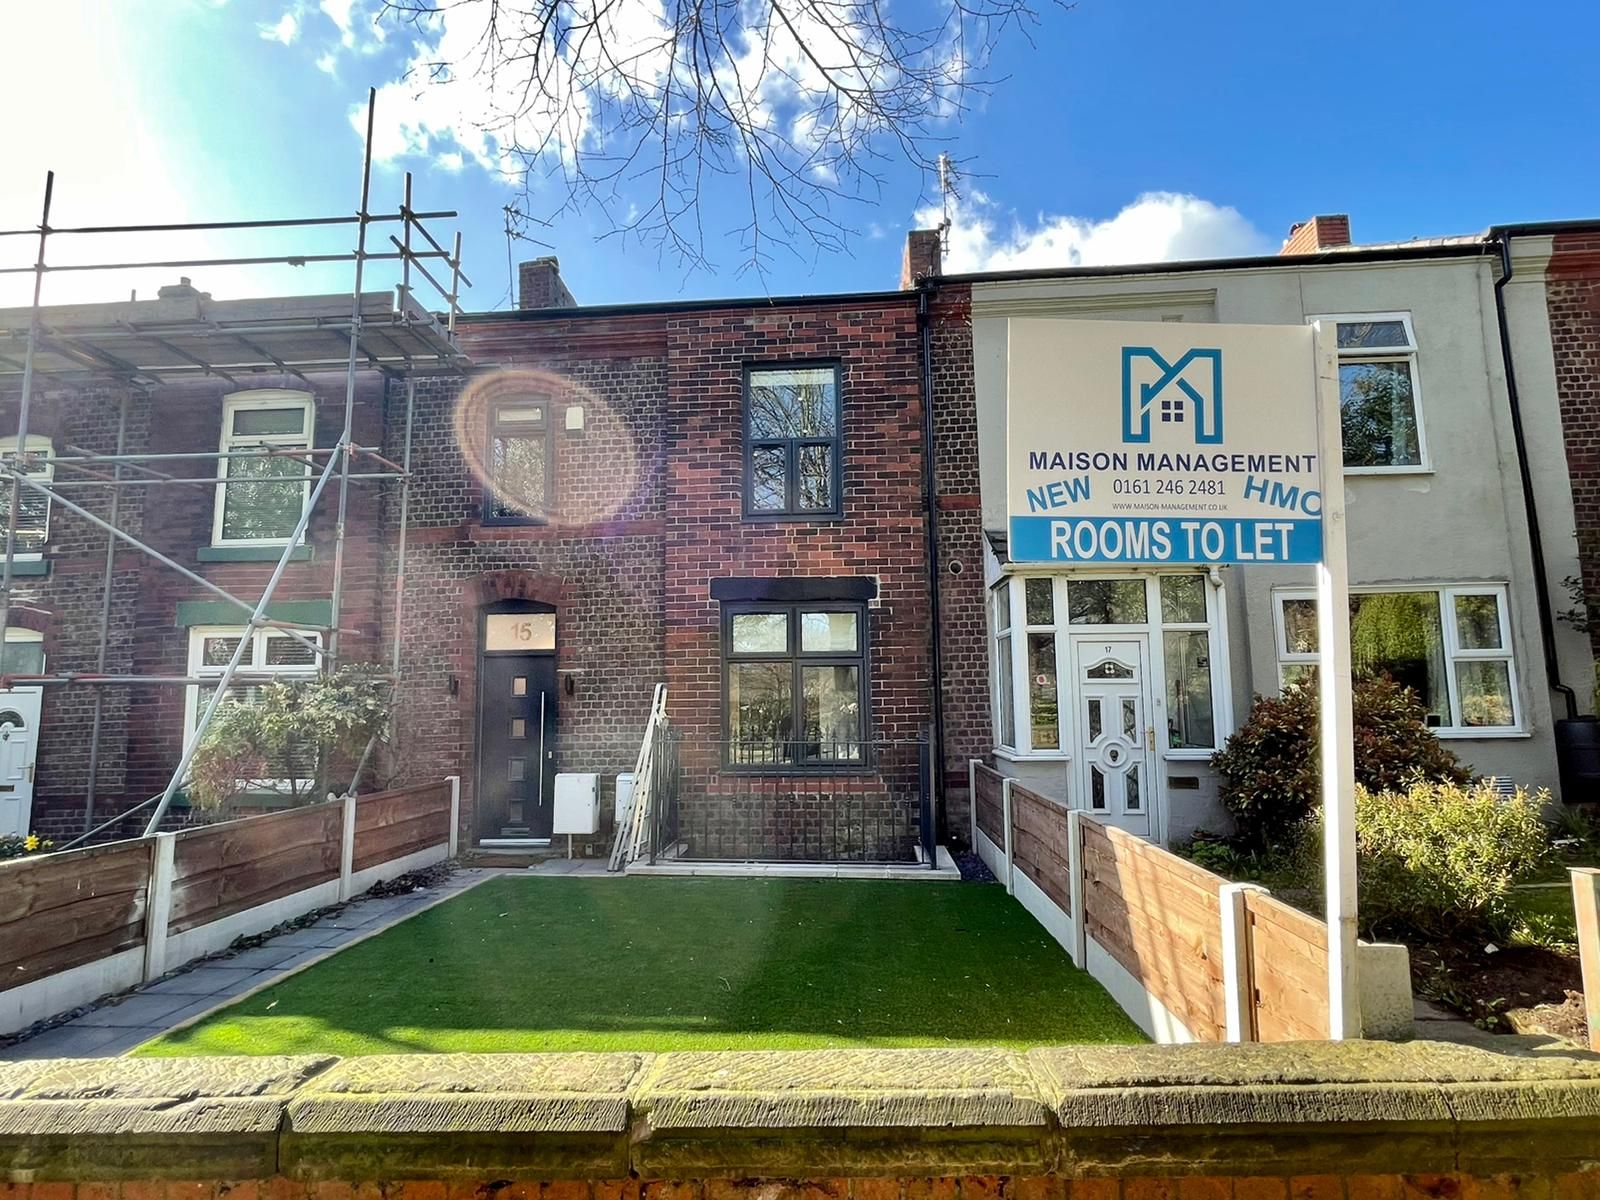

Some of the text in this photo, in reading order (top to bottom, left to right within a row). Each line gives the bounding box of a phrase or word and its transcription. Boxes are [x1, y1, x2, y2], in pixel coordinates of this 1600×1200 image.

[1029, 452, 1317, 473] MAISON MANAGEMENT
[1026, 476, 1091, 512] NEW
[1113, 479, 1226, 495] 0161 246 2481
[1051, 520, 1295, 561] ROOMS TO LET
[510, 622, 532, 641] 15
[1104, 645, 1112, 654] 17
